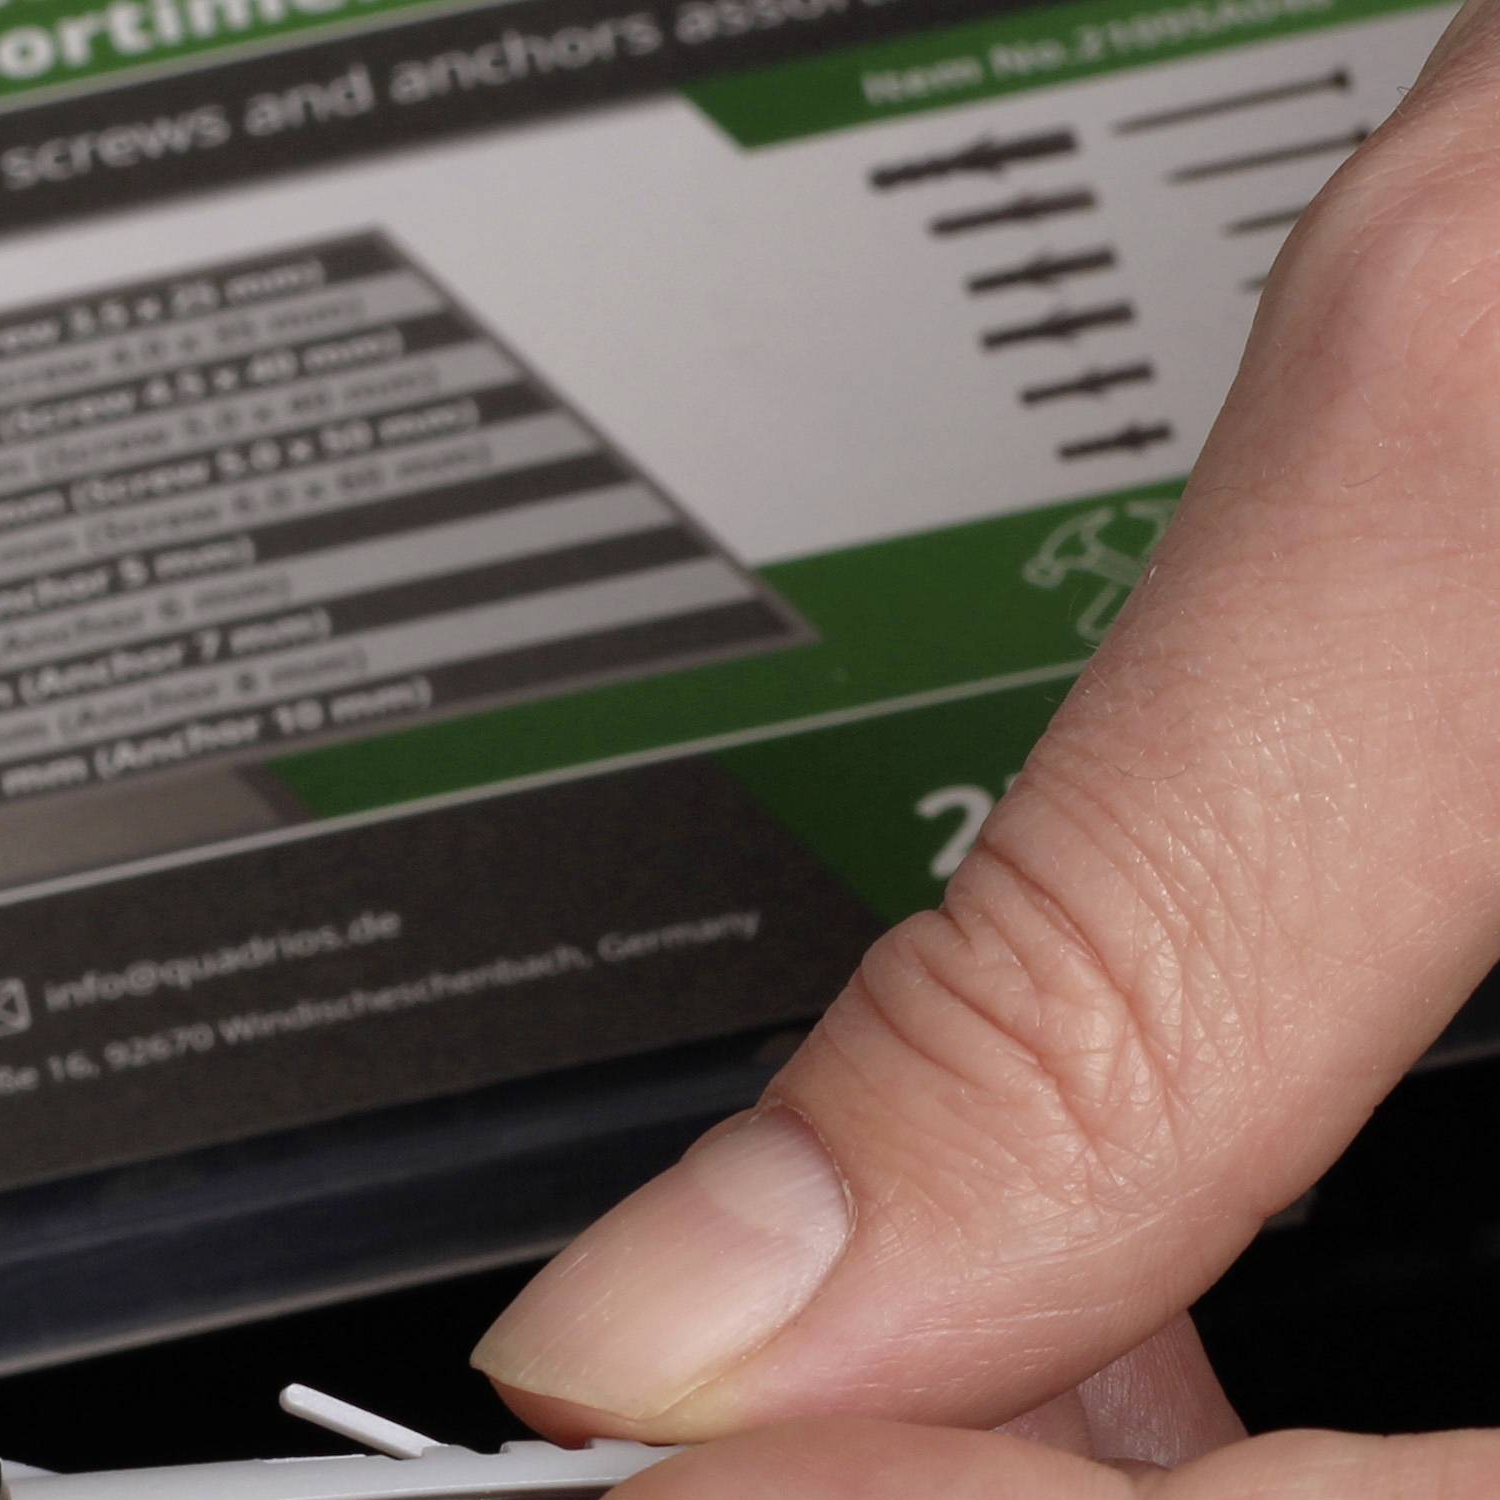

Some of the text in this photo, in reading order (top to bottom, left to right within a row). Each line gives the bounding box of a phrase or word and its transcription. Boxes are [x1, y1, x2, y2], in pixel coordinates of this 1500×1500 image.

[1, 105, 229, 191] screws
[245, 62, 375, 138] and
[389, 13, 663, 105] anchors
[226, 254, 326, 306] mm)
[304, 324, 402, 376] mm)
[72, 454, 211, 514] (Screw
[378, 396, 479, 448] mm)
[154, 533, 257, 585] mm)
[20, 637, 189, 704] (Anchor
[226, 605, 333, 659] mm)
[92, 712, 262, 779] (Anchor
[328, 674, 434, 728] mm)
[45, 911, 400, 1011] info@quadrios.de
[48, 1051, 99, 1083] 16,
[105, 1023, 214, 1071] 92670
[599, 911, 761, 961] Germany
